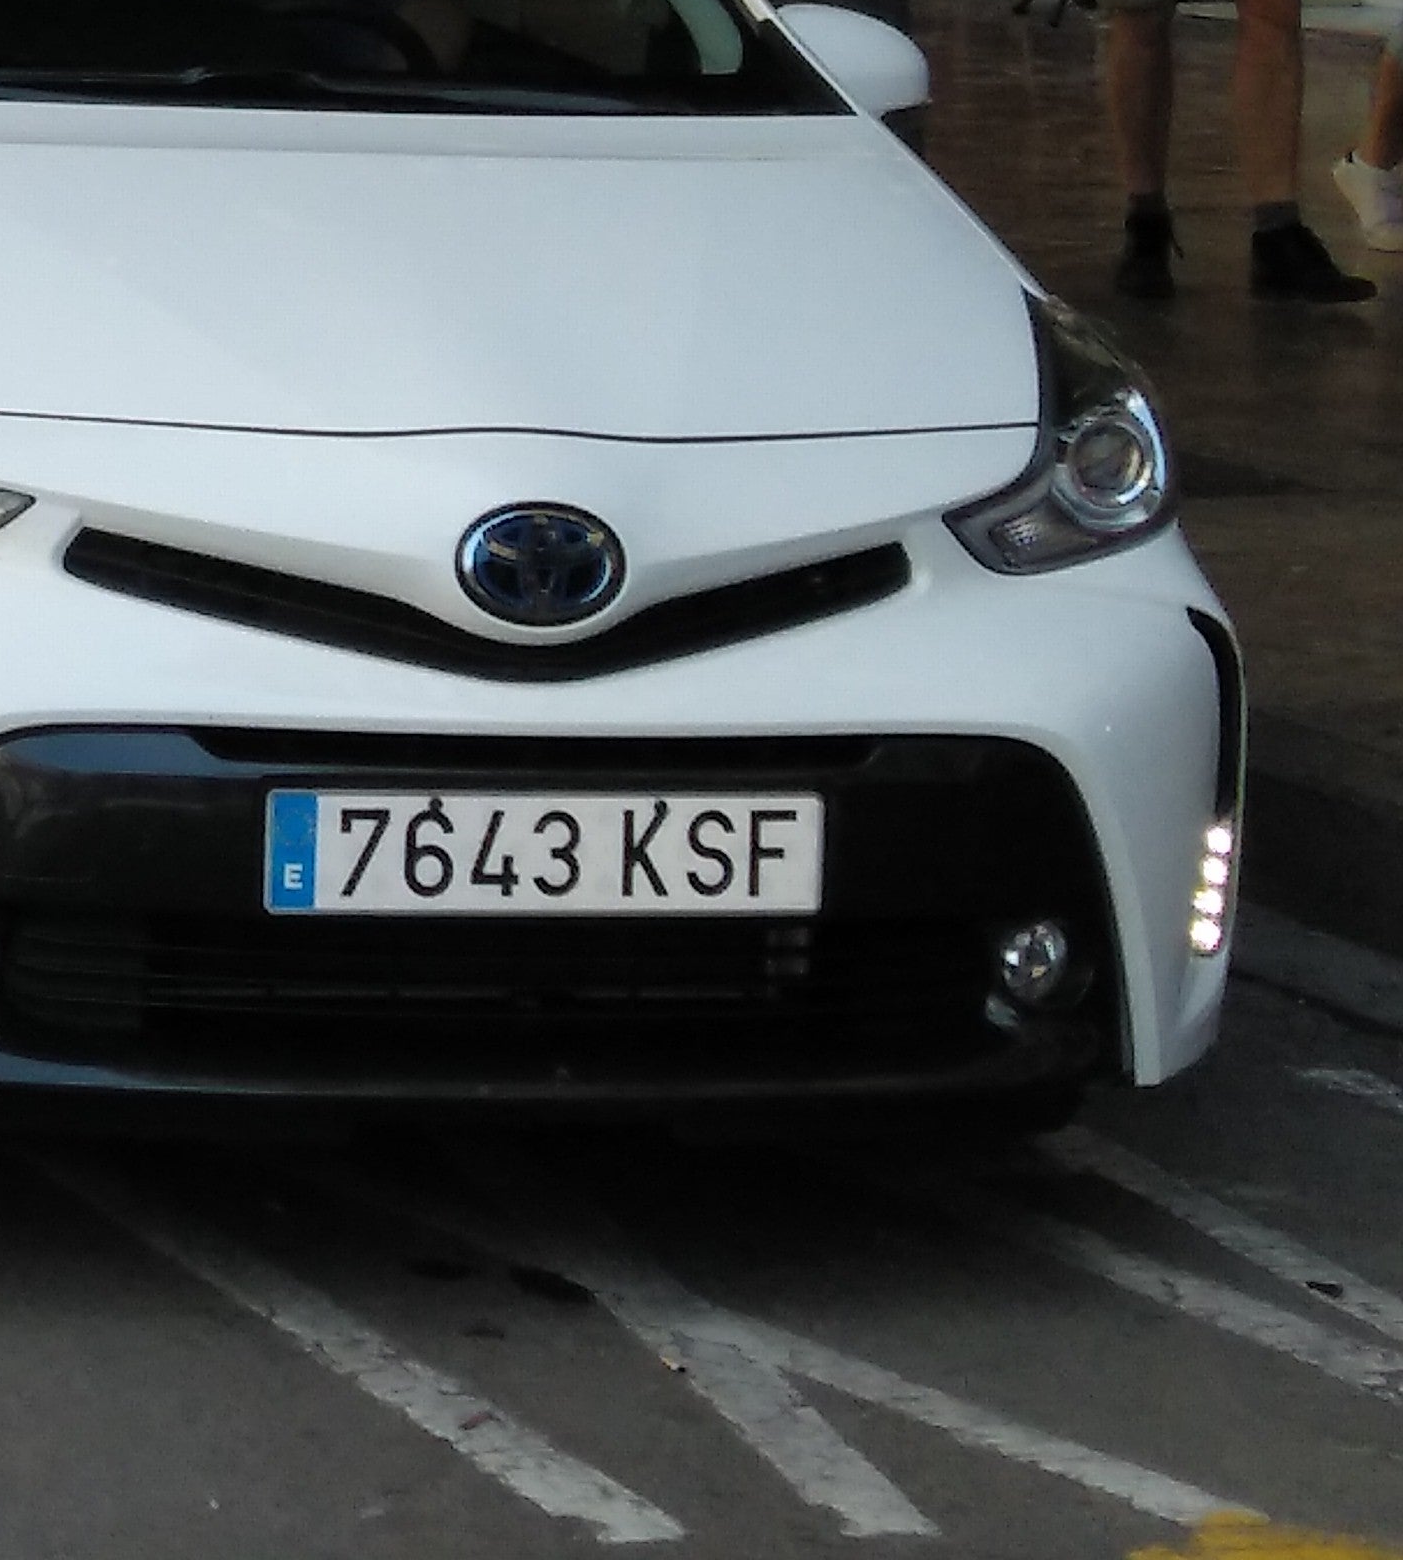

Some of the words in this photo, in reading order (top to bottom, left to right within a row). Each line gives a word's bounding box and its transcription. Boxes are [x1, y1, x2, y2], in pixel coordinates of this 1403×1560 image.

[283, 863, 304, 890] E
[340, 807, 582, 899] 7643
[621, 807, 798, 898] KSF
